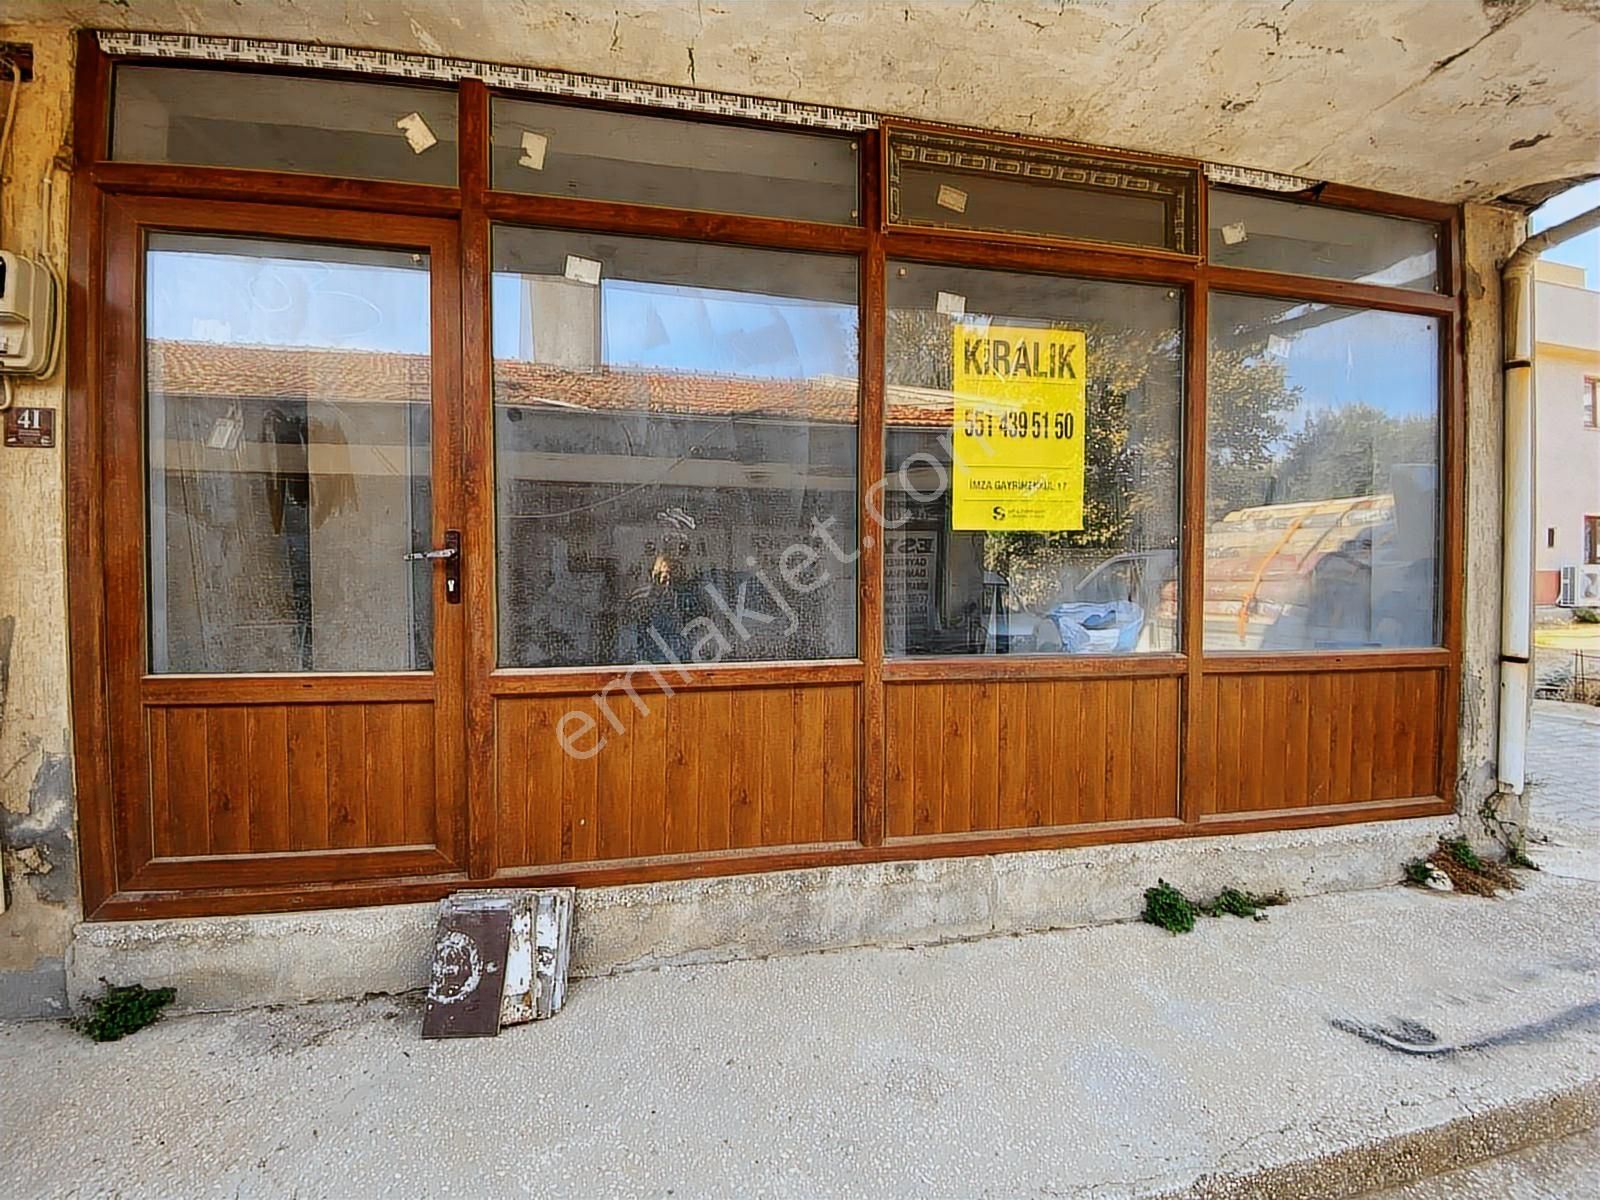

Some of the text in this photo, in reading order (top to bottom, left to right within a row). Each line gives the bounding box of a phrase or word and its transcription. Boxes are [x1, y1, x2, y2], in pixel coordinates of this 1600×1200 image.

[964, 338, 1077, 379] KİRALIK
[17, 409, 40, 429] 41
[964, 410, 993, 437] 551
[1032, 412, 1049, 439] 51
[1054, 413, 1075, 440] 50
[994, 479, 1055, 492] GAYRİMENUL
